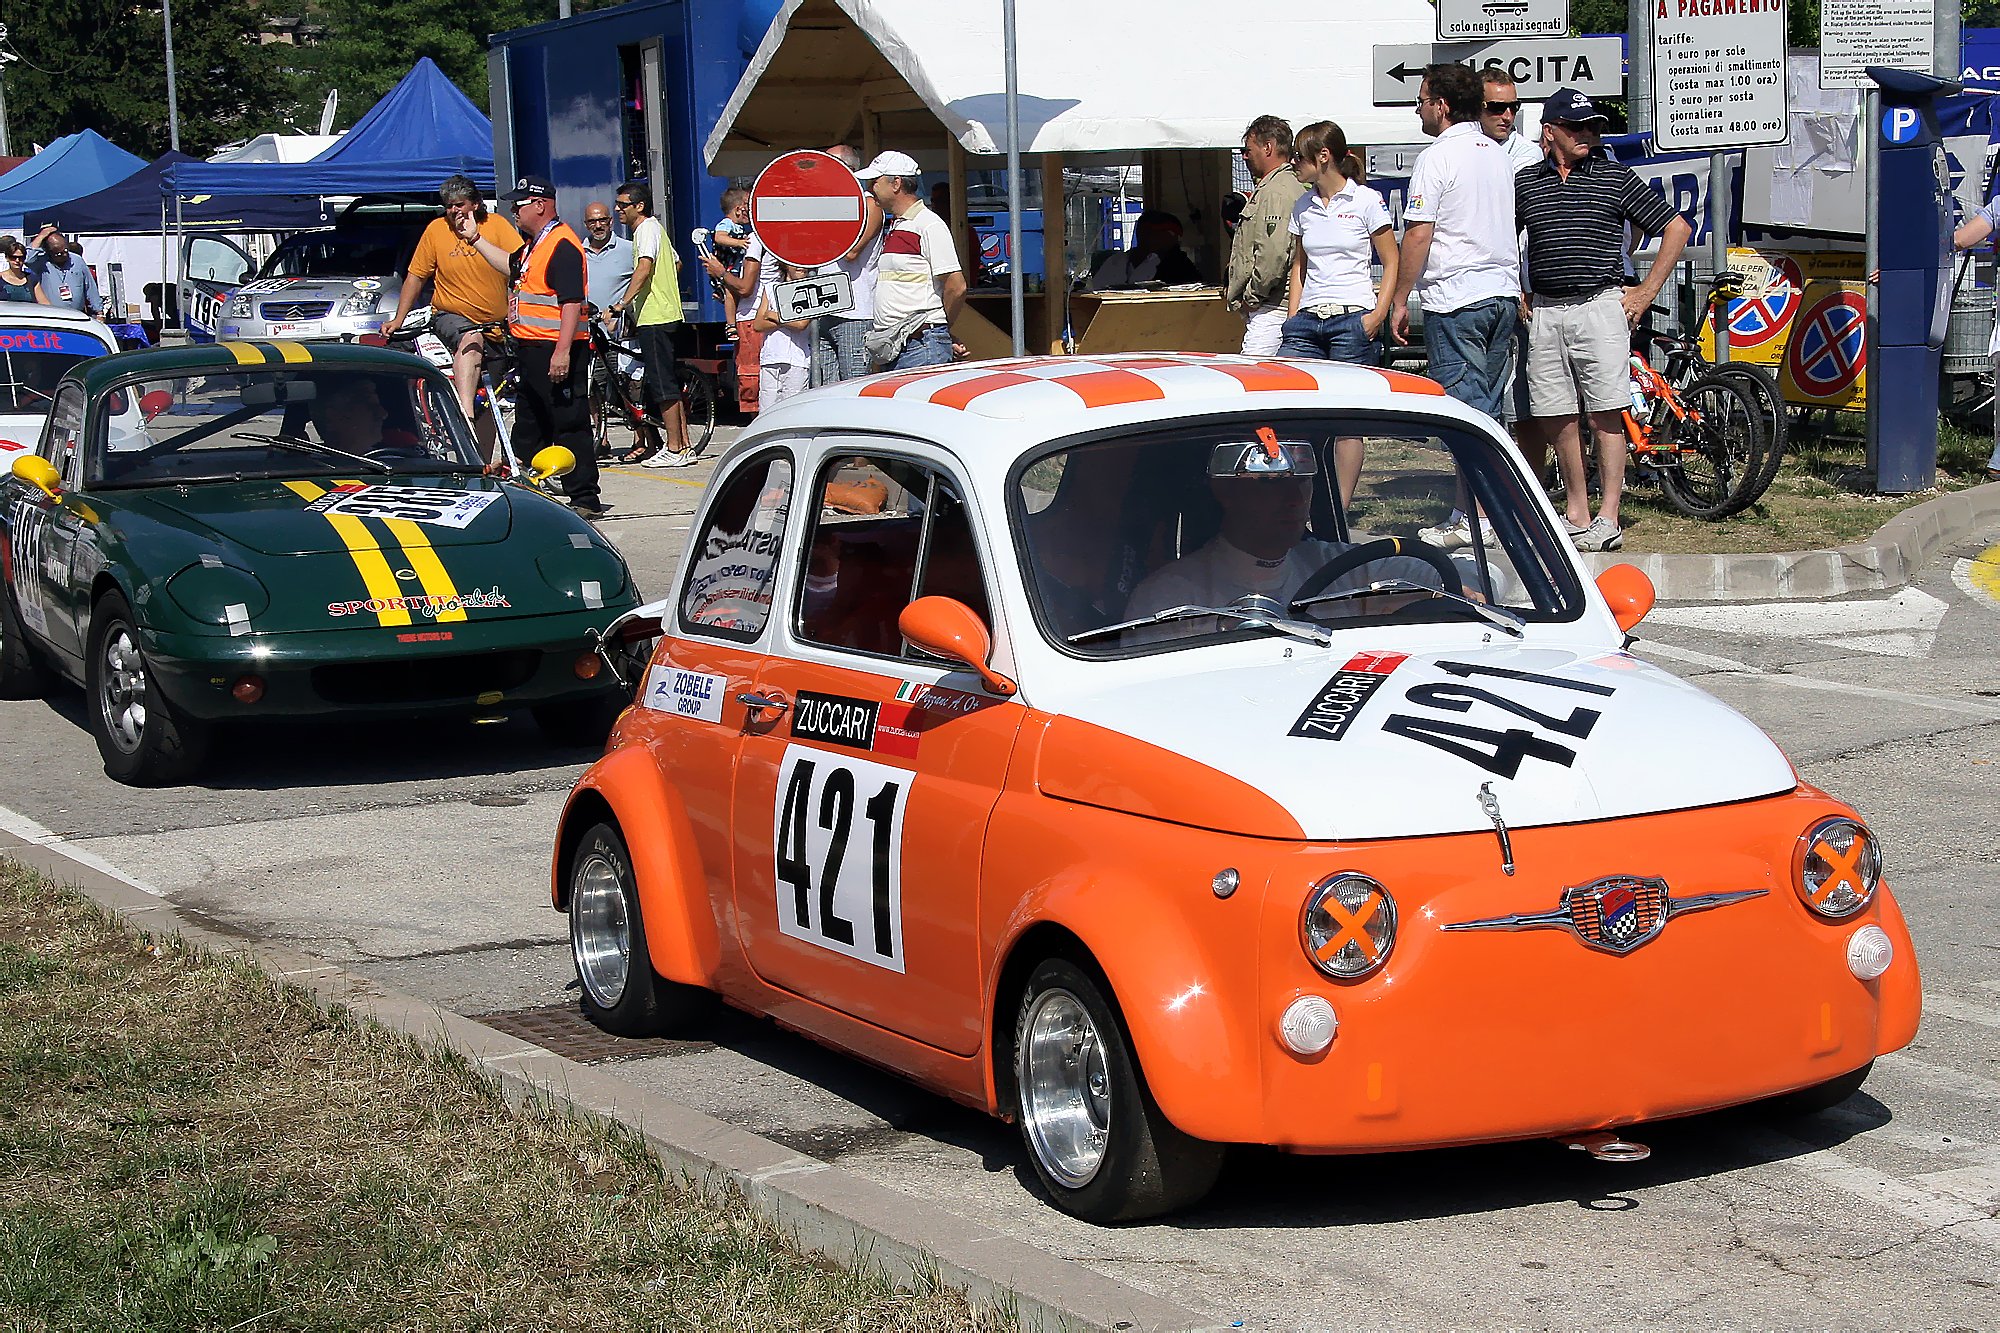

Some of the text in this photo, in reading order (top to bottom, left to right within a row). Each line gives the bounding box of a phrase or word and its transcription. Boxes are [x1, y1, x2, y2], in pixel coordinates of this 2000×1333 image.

[1450, 17, 1561, 34] solo negli spazi segnati
[1658, 33, 1694, 45] tariffe:
[1678, 50, 1699, 59] euro
[1705, 49, 1720, 59] per
[1726, 45, 1746, 56] sole
[1668, 59, 1781, 76] operazioni di smaltimento
[1669, 72, 1778, 91] (sosta max 1.00 ora)
[1669, 91, 1754, 105] 5 euro per sosta
[1669, 108, 1723, 122] giornaliera
[1670, 118, 1782, 137] (sosta max 48.00 ore)
[673, 672, 714, 700] ZOBELE
[677, 697, 702, 715] GROUP
[1301, 675, 1378, 734] ZUCCARI
[797, 698, 871, 741] ZUCCARI
[1381, 660, 1616, 780] 421
[777, 758, 900, 959] 421
